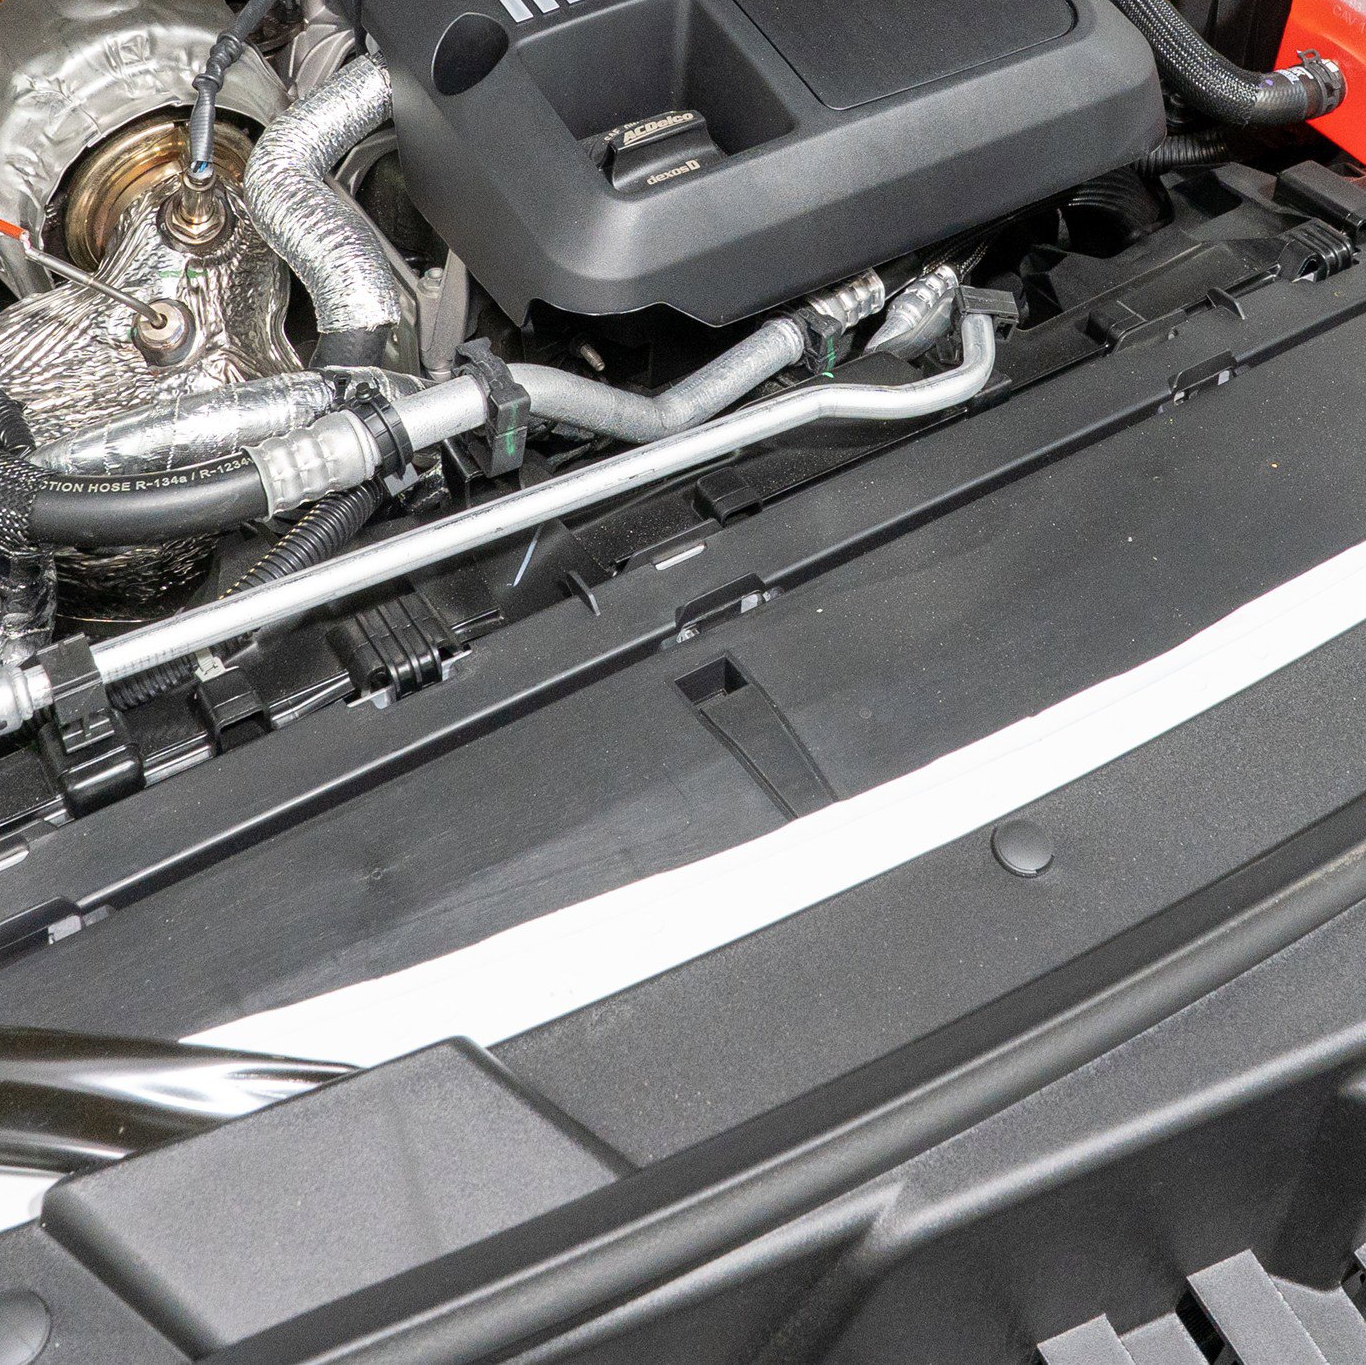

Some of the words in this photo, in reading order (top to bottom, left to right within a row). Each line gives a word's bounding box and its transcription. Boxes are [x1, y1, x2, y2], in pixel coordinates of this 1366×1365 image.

[623, 112, 695, 144] ACDelco
[87, 482, 132, 494] HOSE
[135, 475, 188, 491] R-134a
